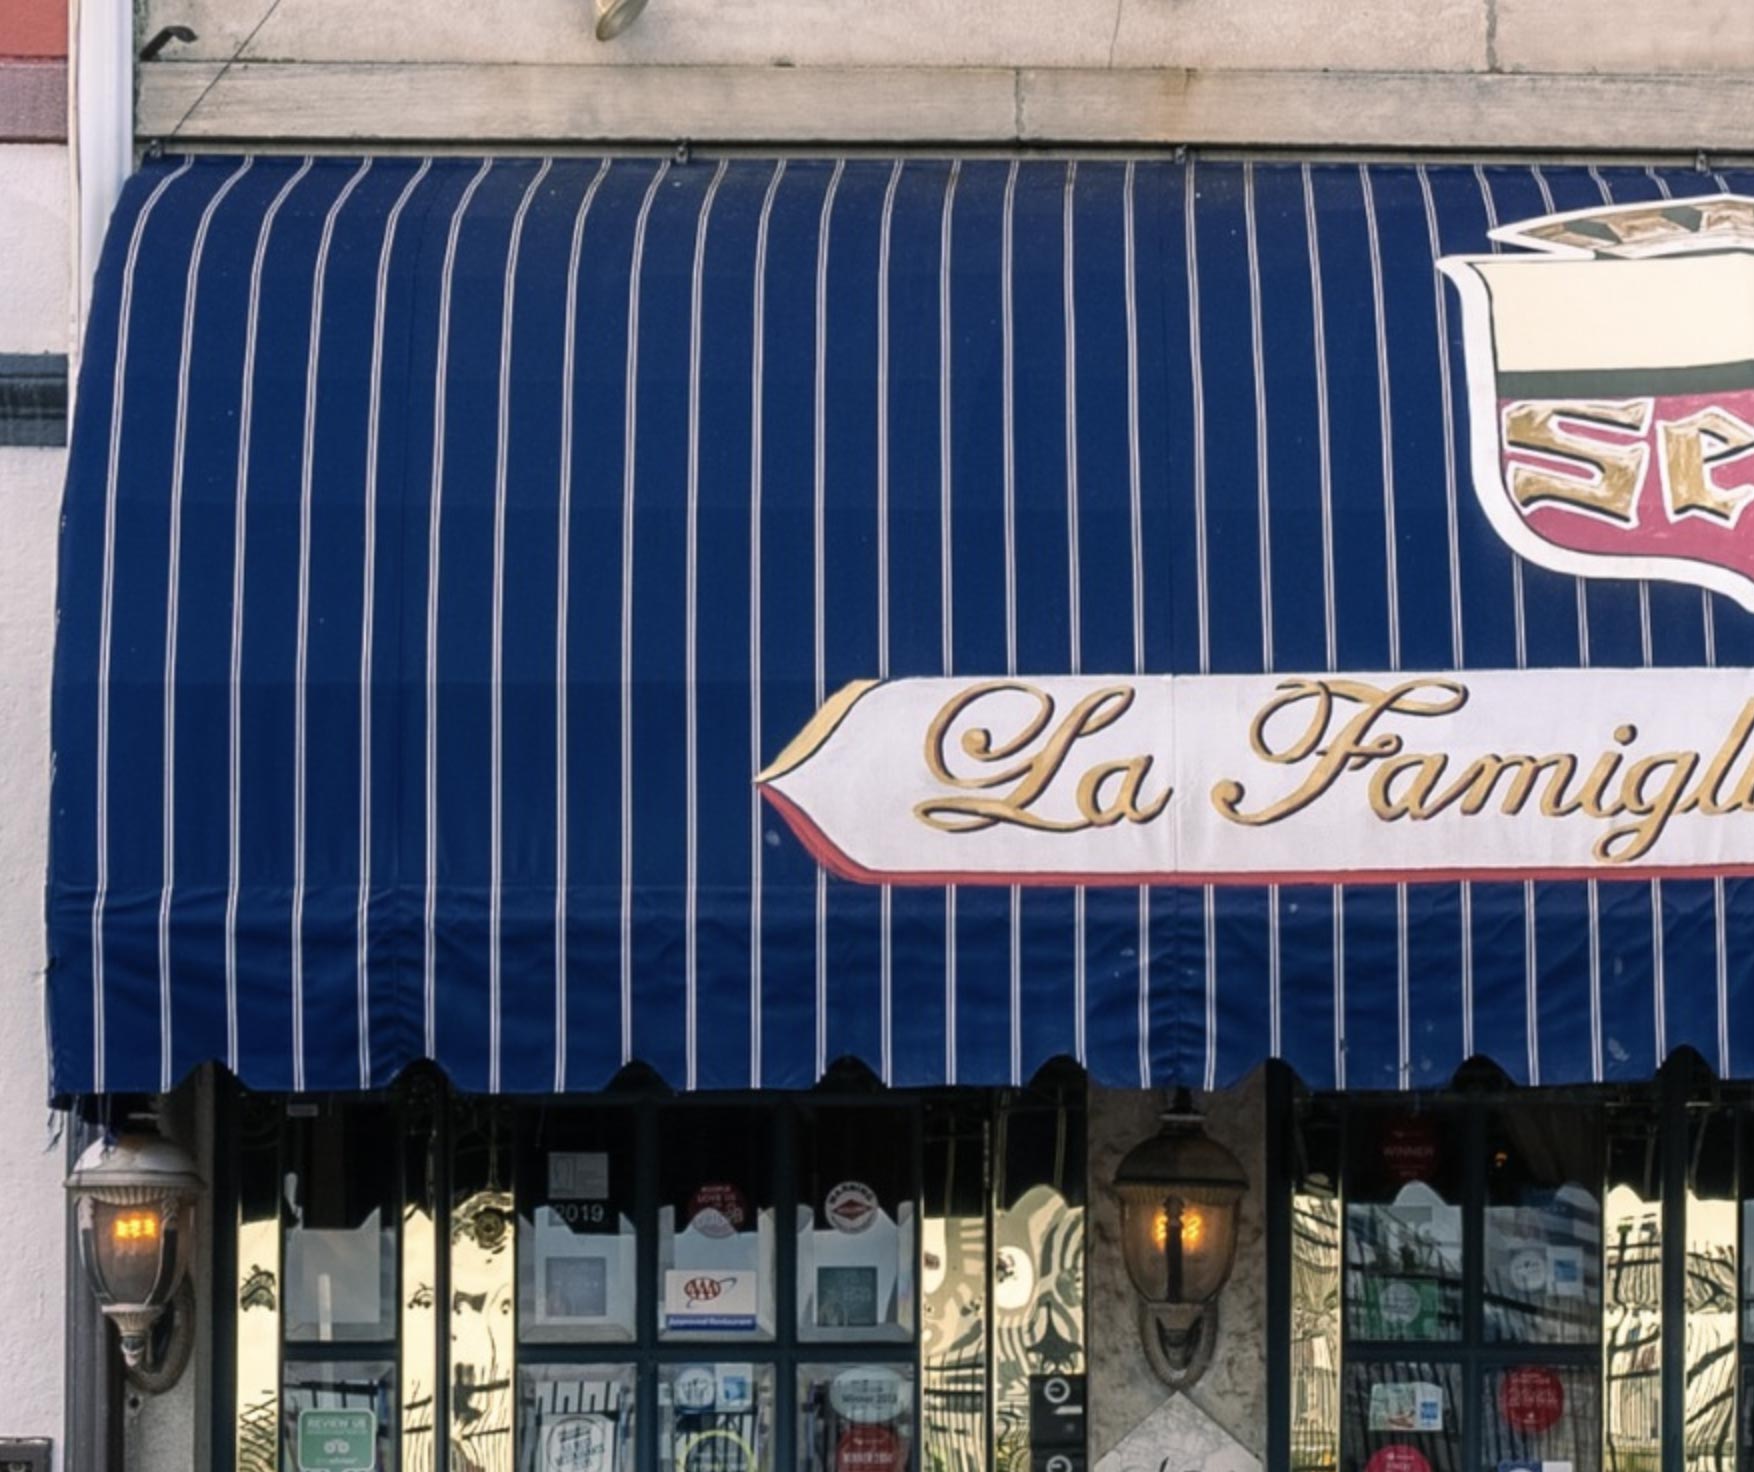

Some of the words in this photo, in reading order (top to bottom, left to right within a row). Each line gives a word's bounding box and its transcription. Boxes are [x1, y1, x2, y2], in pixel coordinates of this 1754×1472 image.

[912, 679, 1174, 833] La
[829, 1181, 874, 1206] WARNING
[554, 1203, 605, 1224] 2019
[685, 1277, 722, 1301] AAA
[668, 1317, 708, 1327] Approved
[709, 1317, 753, 1326] Restaurant
[306, 1419, 348, 1429] REVIEW
[351, 1419, 367, 1429] US
